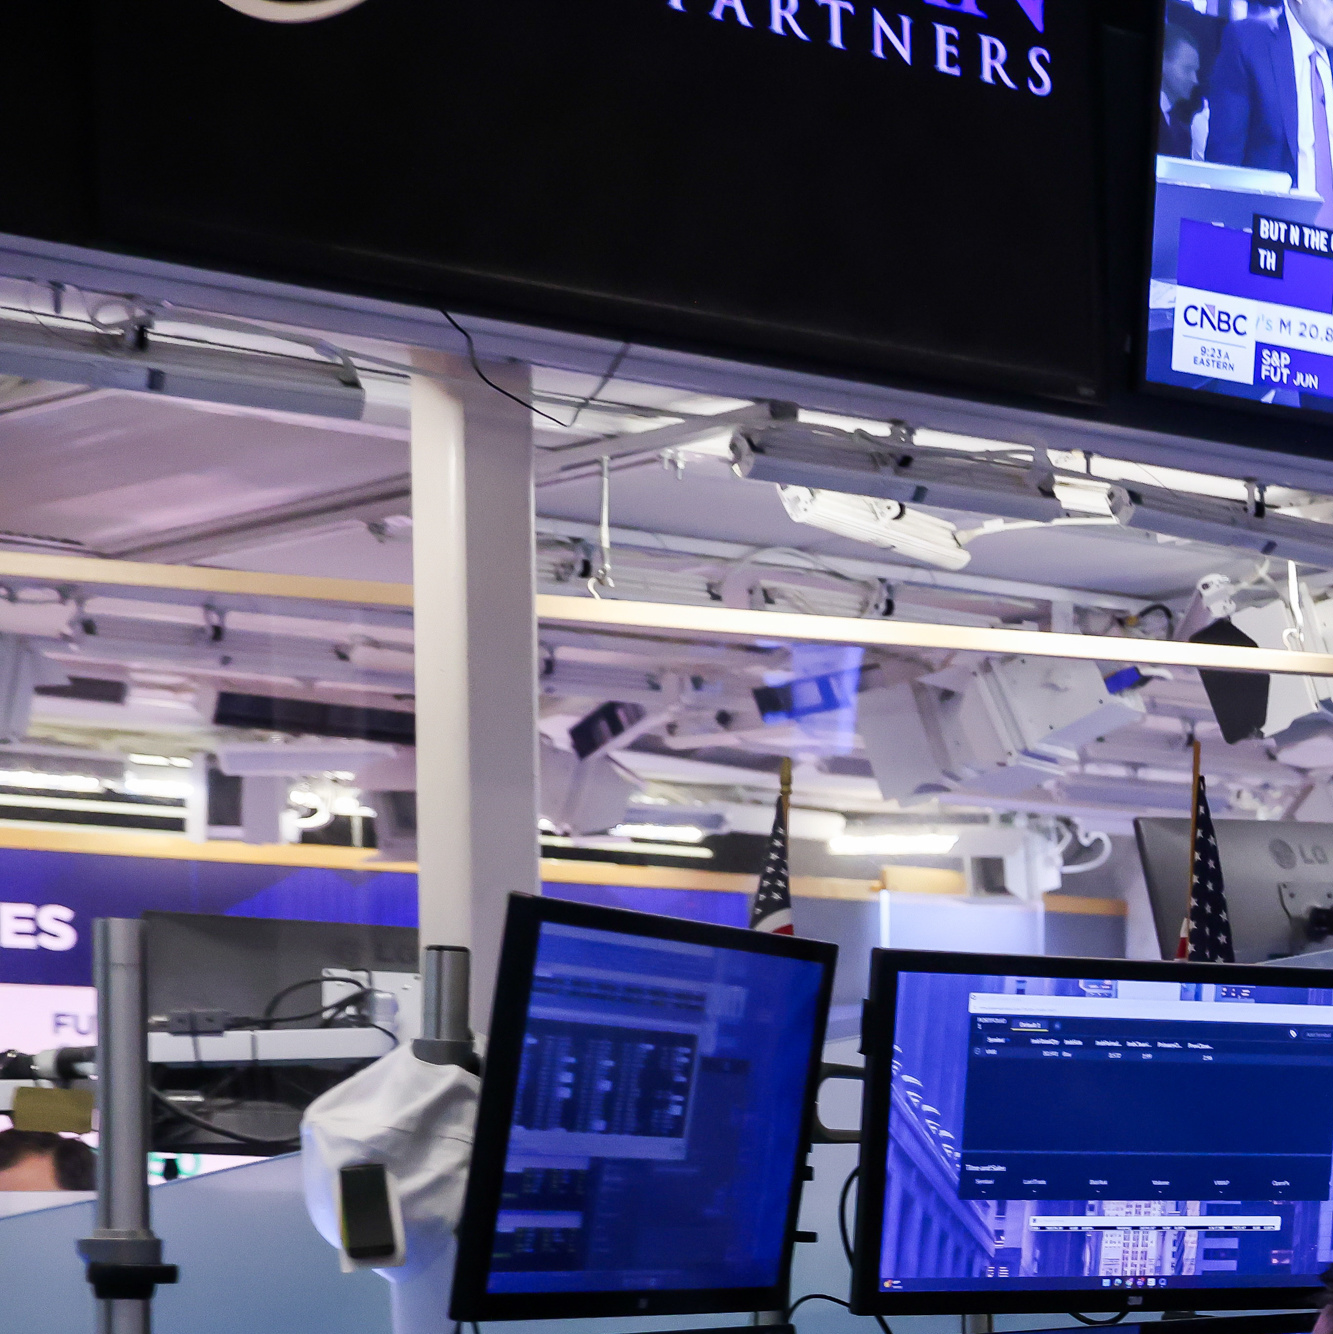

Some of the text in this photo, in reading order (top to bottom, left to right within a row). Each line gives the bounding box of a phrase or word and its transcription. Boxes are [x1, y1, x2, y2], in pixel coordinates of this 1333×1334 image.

[667, 0, 1053, 97] ARTNERS
[1258, 217, 1287, 246] BUT
[1302, 226, 1328, 252] THE
[1258, 248, 1277, 271] TH
[1183, 302, 1248, 337] CNBC
[1279, 318, 1293, 336] M
[1193, 356, 1235, 372] EASTERN
[1261, 348, 1291, 368] S&P
[1260, 365, 1291, 386] FUT
[1292, 372, 1319, 390] JUN
